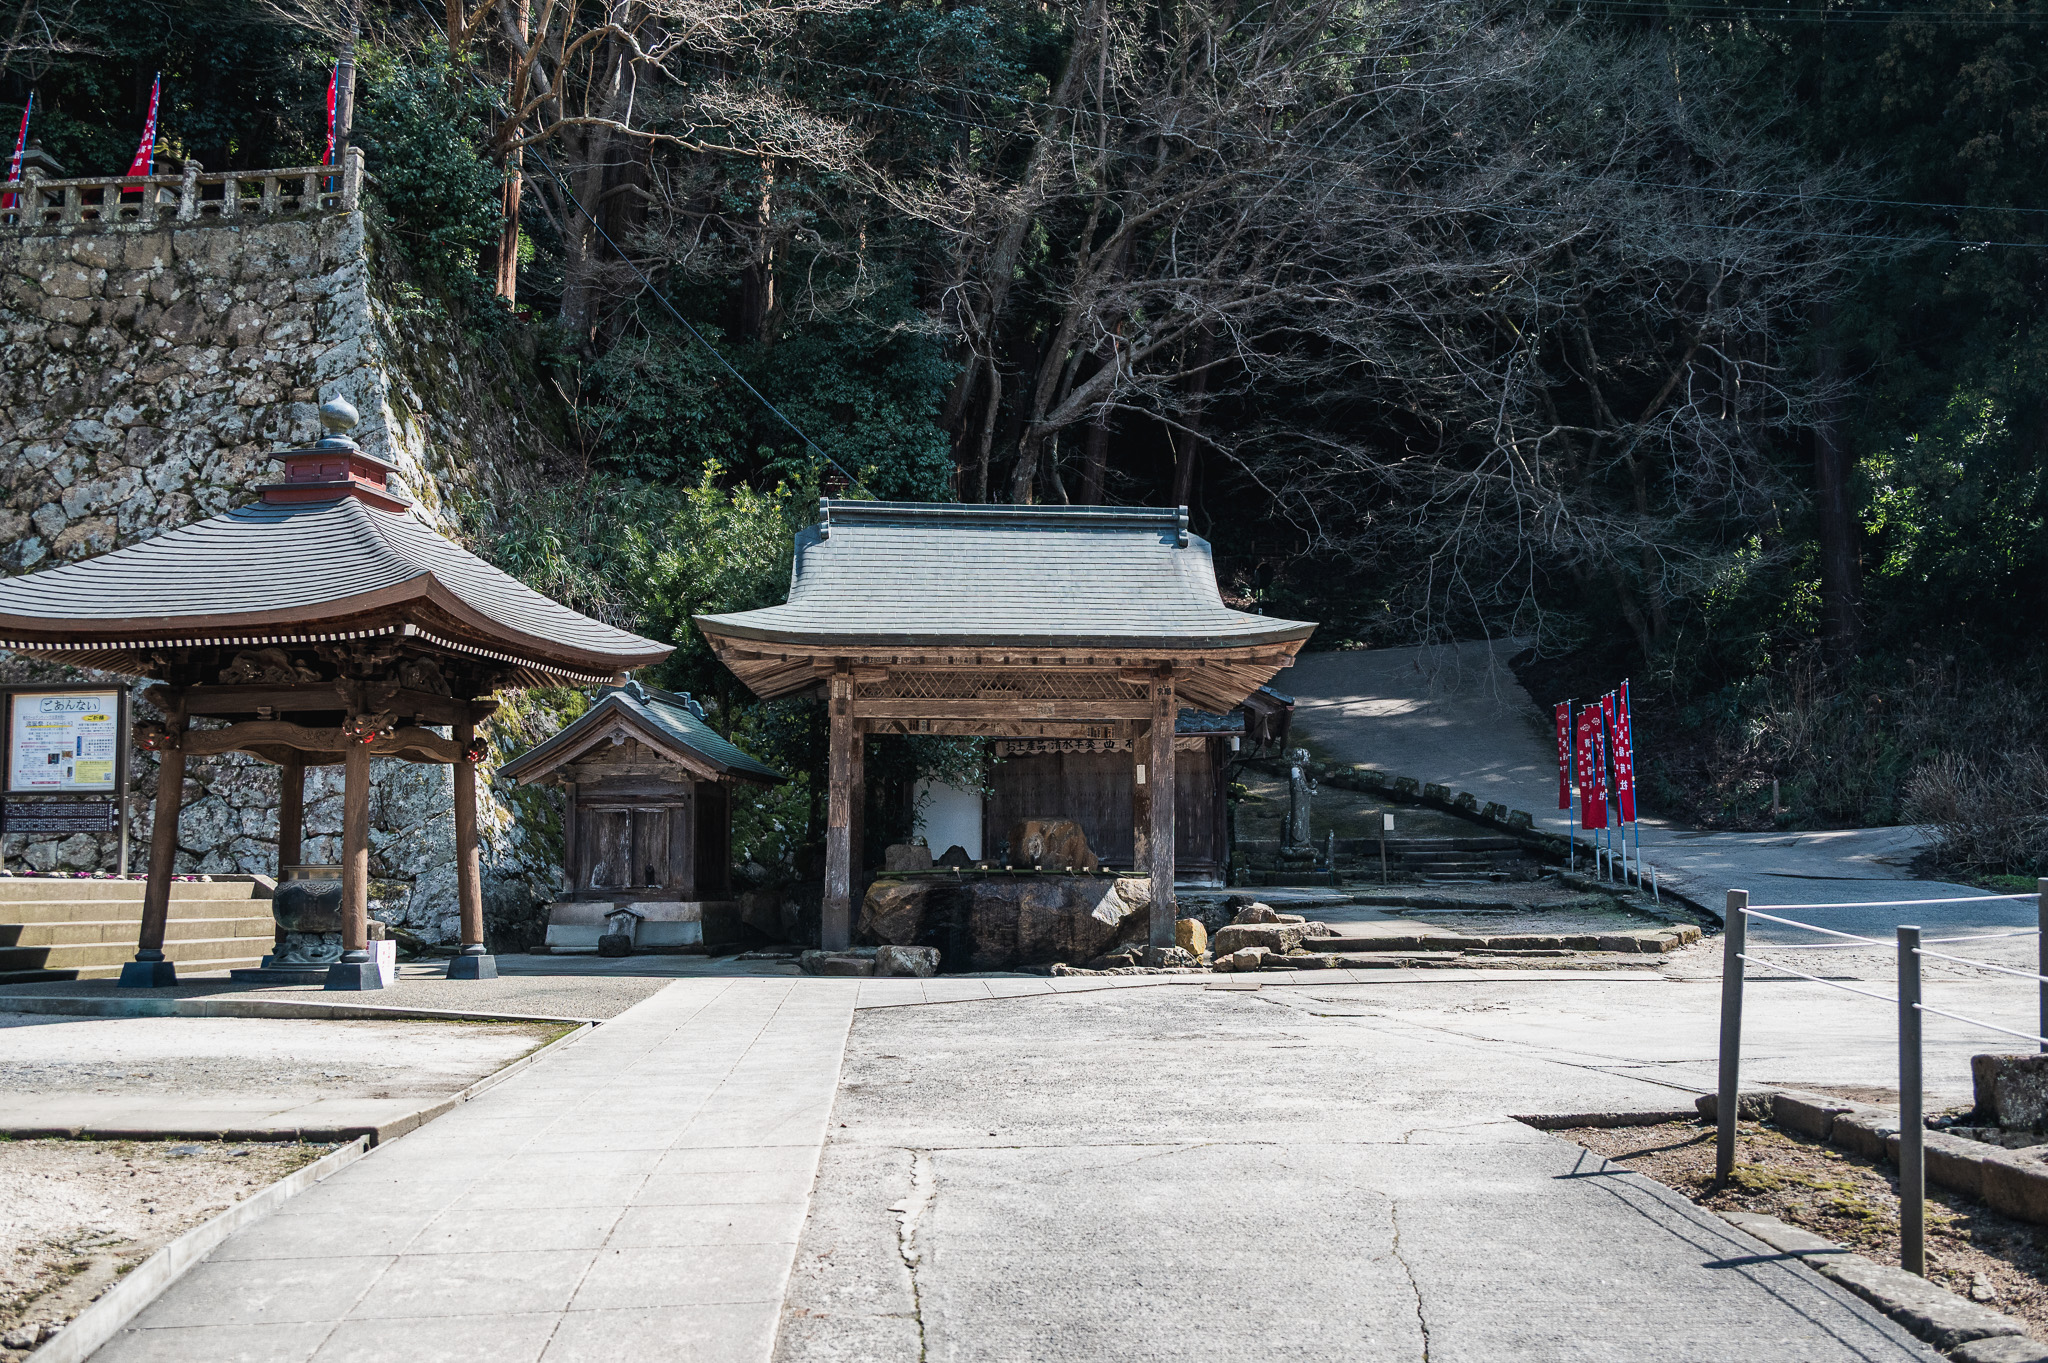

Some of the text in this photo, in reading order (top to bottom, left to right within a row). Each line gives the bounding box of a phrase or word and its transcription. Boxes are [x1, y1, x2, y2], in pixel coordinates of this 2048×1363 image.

[43, 699, 97, 712] ごあんない
